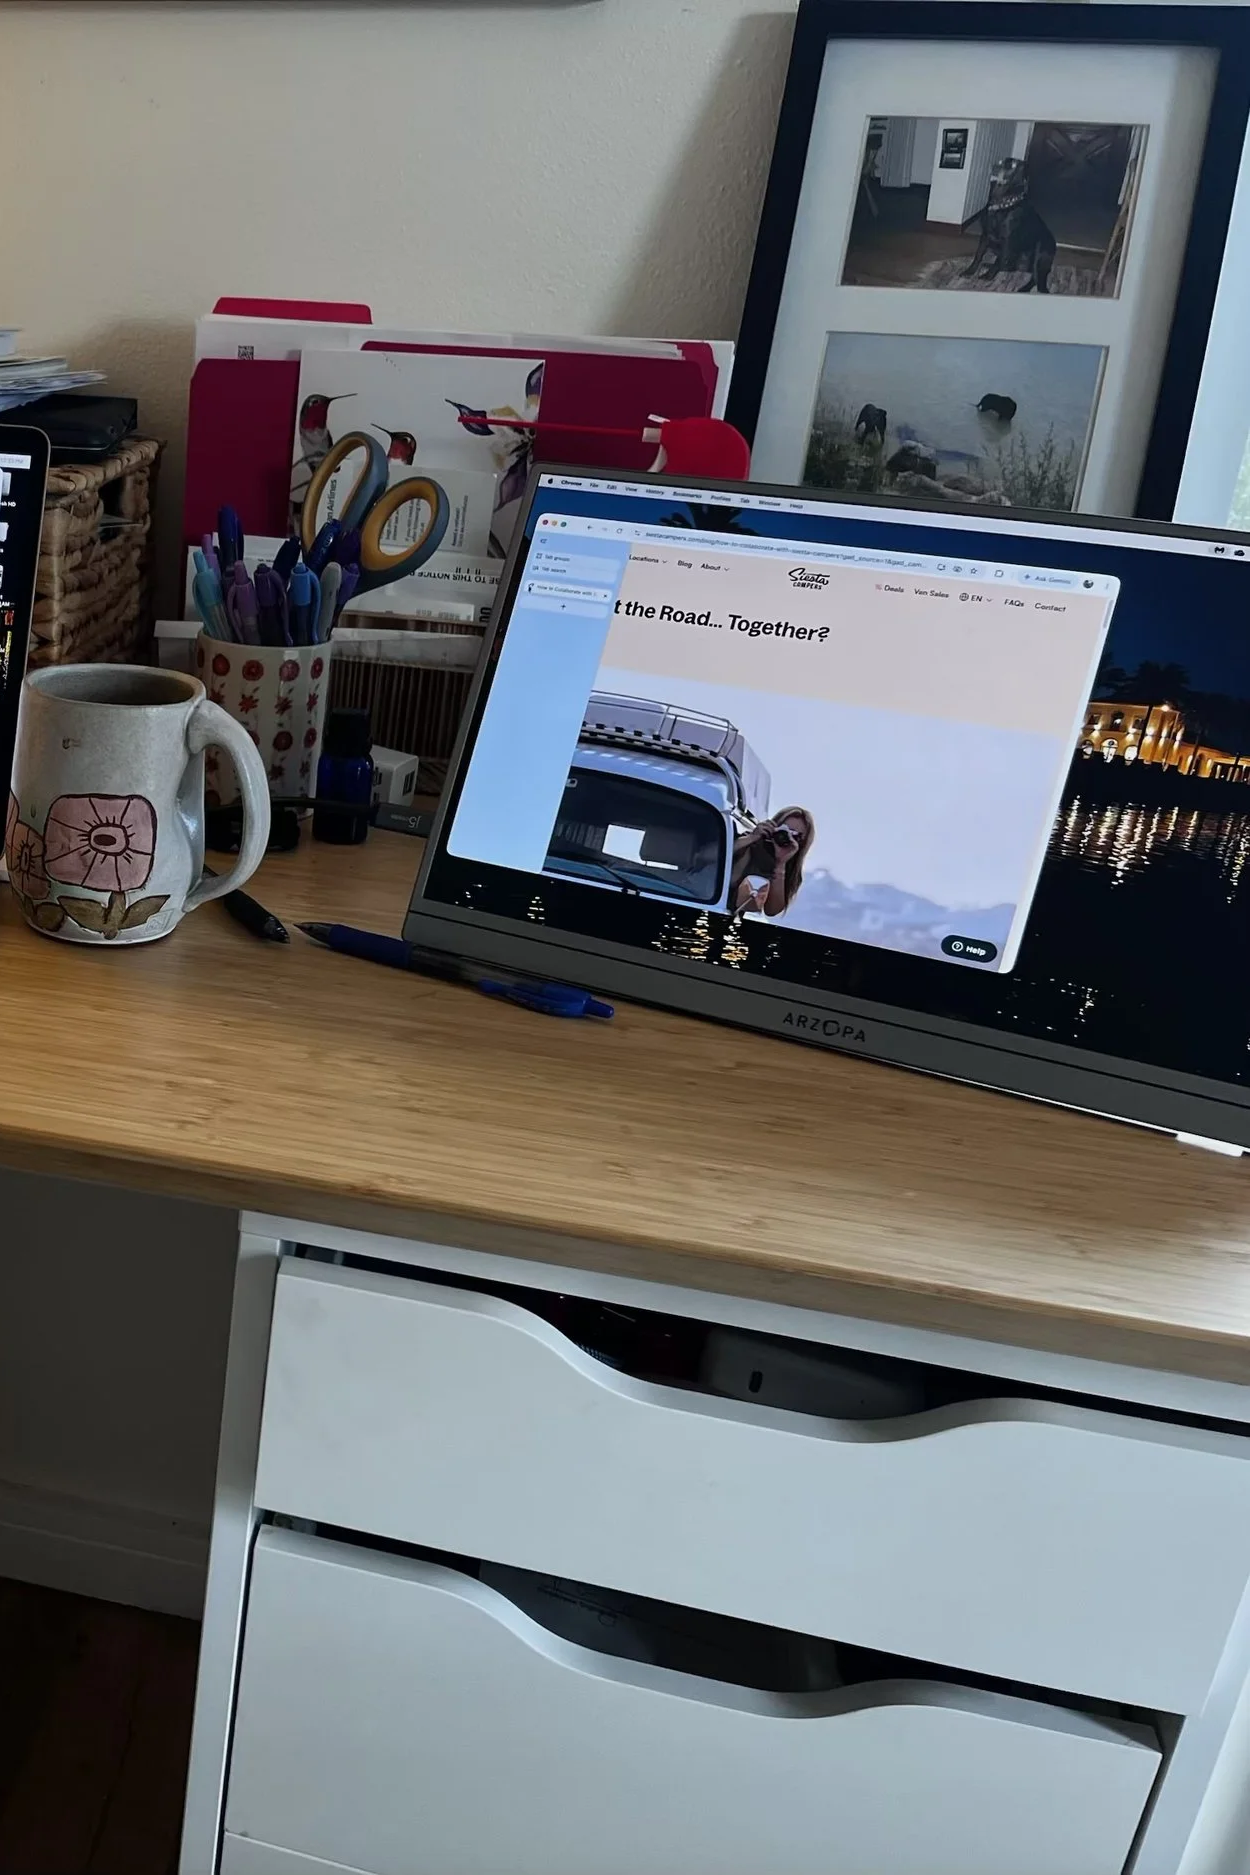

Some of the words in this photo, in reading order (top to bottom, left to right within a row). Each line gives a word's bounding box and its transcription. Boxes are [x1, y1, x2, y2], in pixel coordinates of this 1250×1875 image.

[327, 480, 337, 511] Airlines
[629, 554, 659, 563] Locations
[678, 560, 692, 568] Blog
[700, 563, 720, 571] About
[452, 574, 472, 582] THIS
[475, 576, 486, 584] TO
[788, 568, 830, 586] Siesta
[884, 584, 904, 593] Deals
[914, 588, 928, 596] Van
[929, 590, 949, 599] Sales
[971, 594, 983, 602] EN
[1004, 598, 1024, 608] FAQs
[1034, 602, 1066, 612] Contact
[625, 601, 656, 618] the
[659, 605, 723, 628] Road...
[728, 614, 830, 642] Together?
[966, 945, 986, 957] Help
[782, 1012, 866, 1042] ARZOPA
